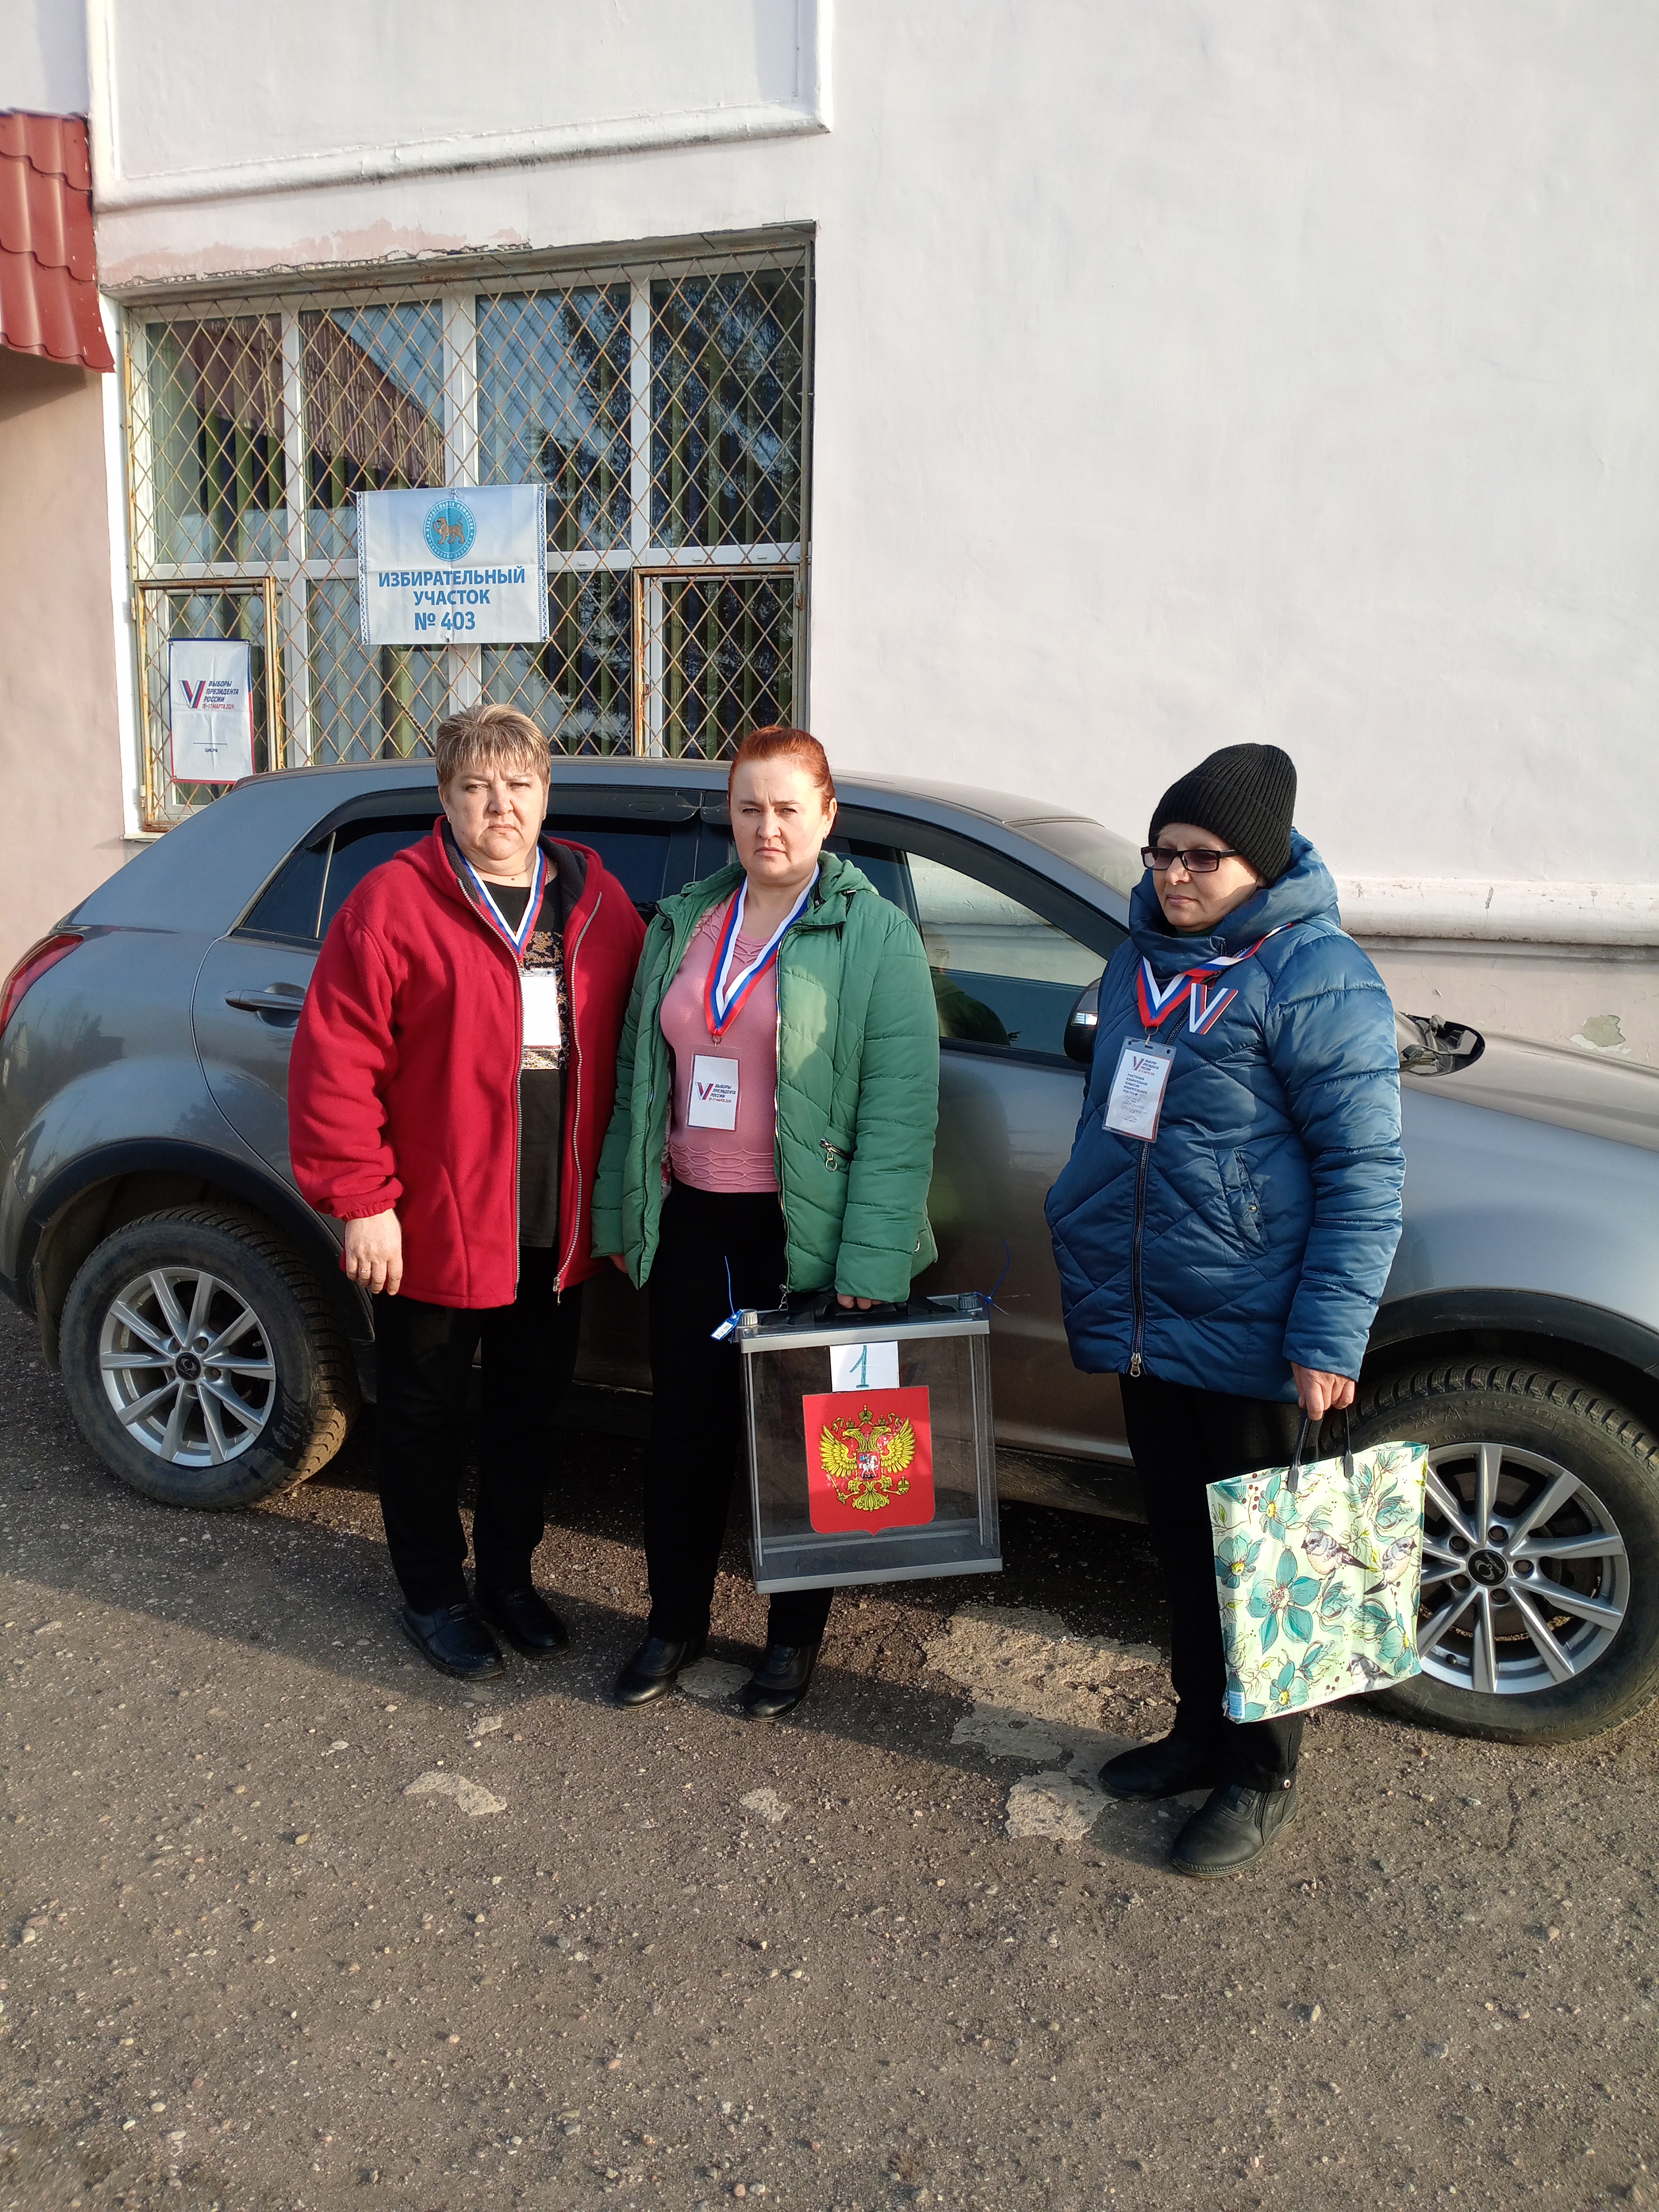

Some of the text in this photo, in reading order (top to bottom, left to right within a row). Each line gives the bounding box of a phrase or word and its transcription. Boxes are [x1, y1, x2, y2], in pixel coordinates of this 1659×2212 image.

[379, 566, 525, 587] ИЗБИРАТЕЛЬНЫЙ
[413, 589, 491, 606] УЧАСТОК
[415, 611, 476, 630] № 403
[850, 1345, 869, 1388] 1
